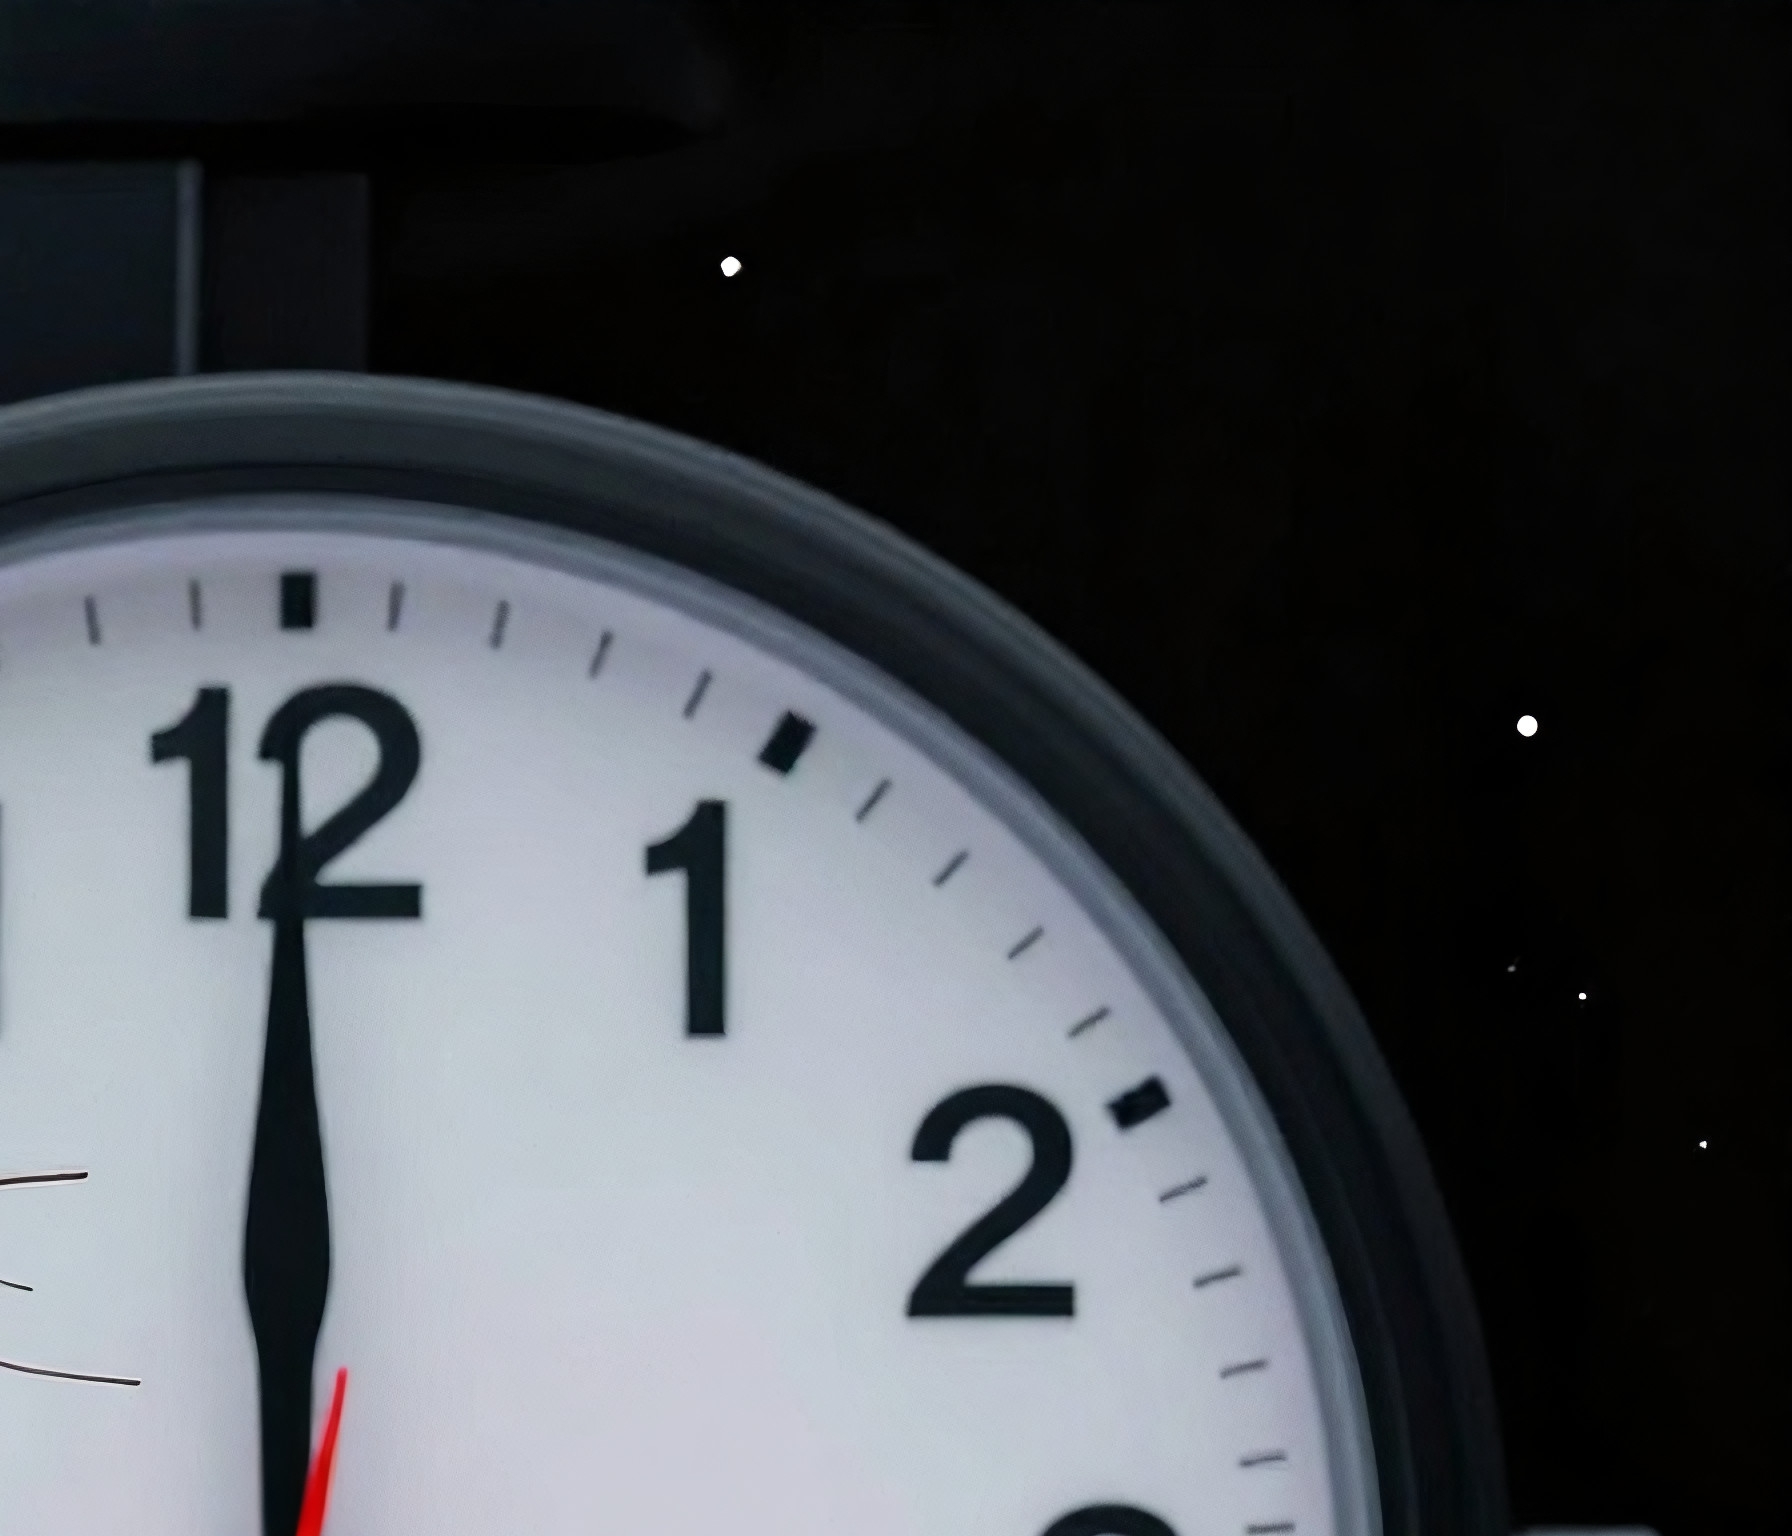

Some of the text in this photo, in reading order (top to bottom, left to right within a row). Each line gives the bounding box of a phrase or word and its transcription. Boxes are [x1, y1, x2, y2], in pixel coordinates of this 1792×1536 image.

[149, 682, 423, 922] 12
[644, 799, 730, 1041] 1
[905, 1083, 1077, 1320] 2
